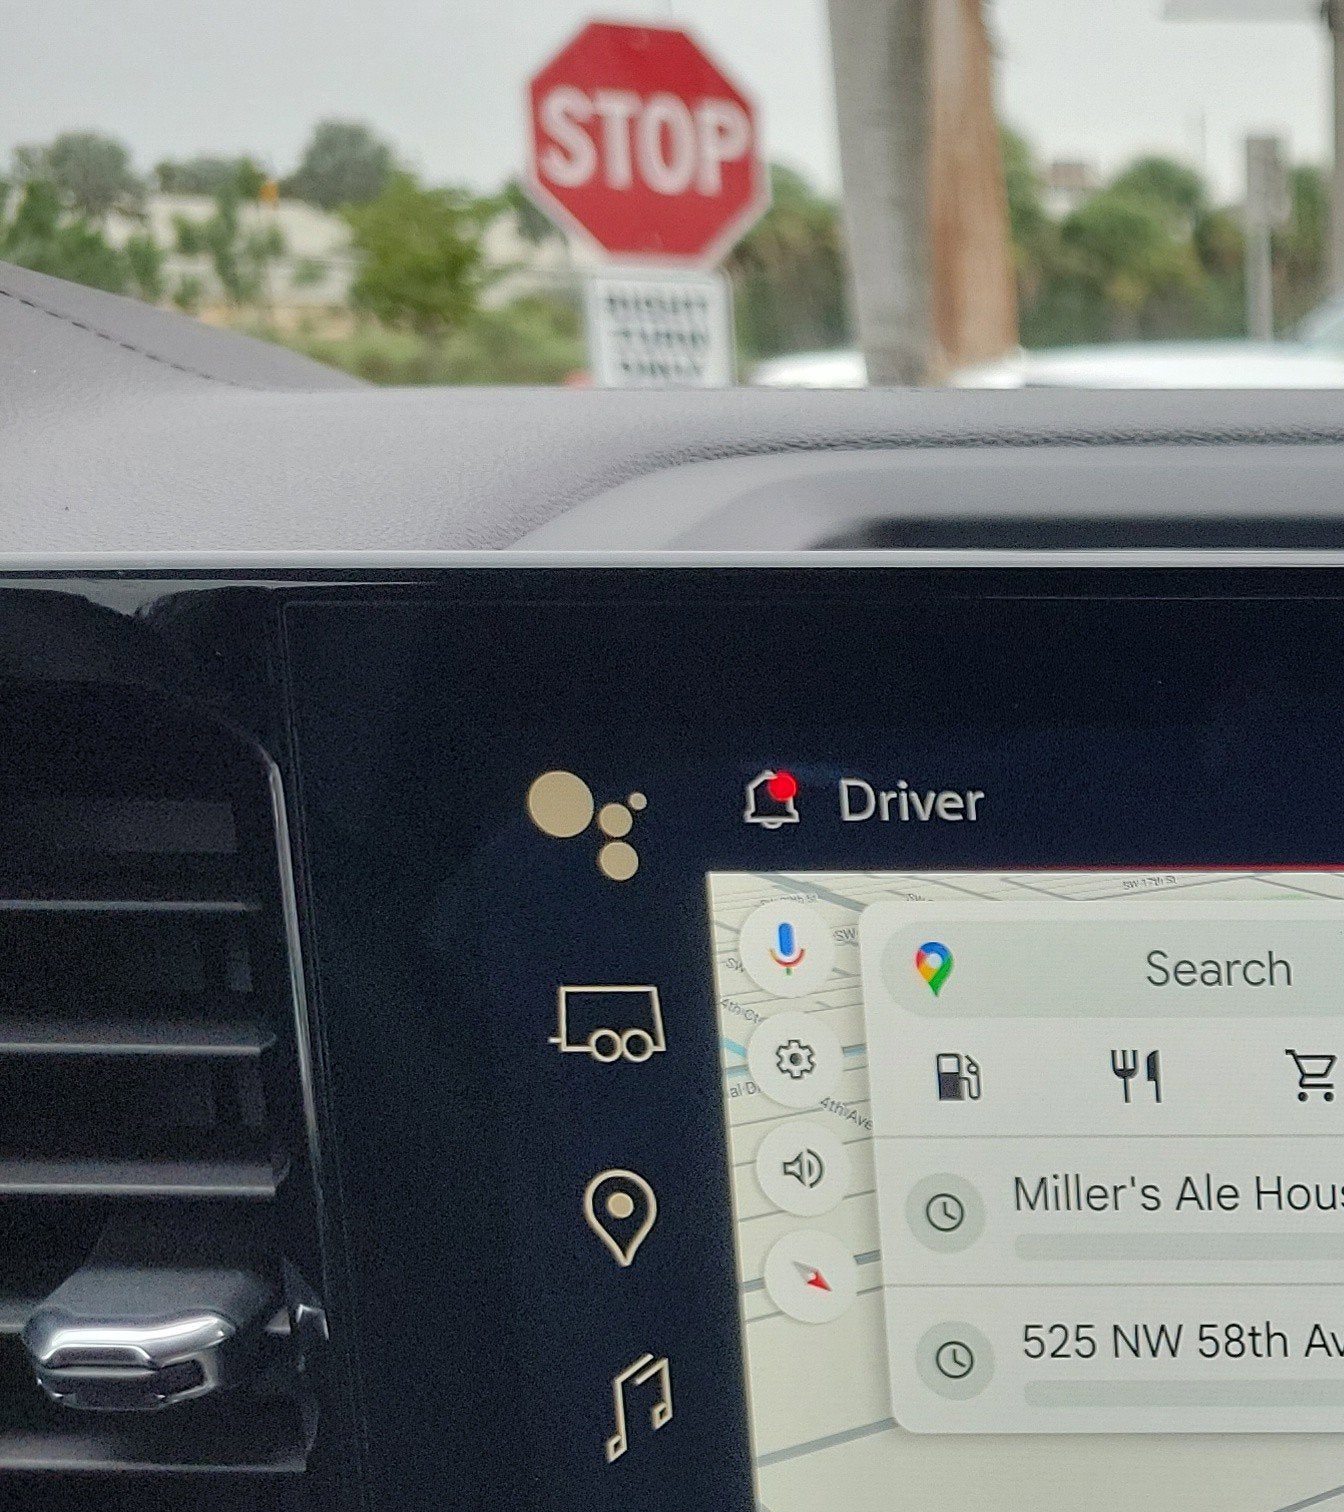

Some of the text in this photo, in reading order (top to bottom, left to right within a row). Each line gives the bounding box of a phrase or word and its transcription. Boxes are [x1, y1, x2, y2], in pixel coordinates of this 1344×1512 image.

[540, 86, 750, 197] STOP
[839, 777, 985, 822] Driver
[1145, 949, 1294, 987] Search
[819, 1096, 873, 1131] 4th Ave
[1013, 1173, 1162, 1211] Miller's
[1175, 1173, 1241, 1211] Ale
[1022, 1323, 1097, 1359] 525
[1112, 1323, 1184, 1359] NW
[1198, 1320, 1289, 1359] 58th
